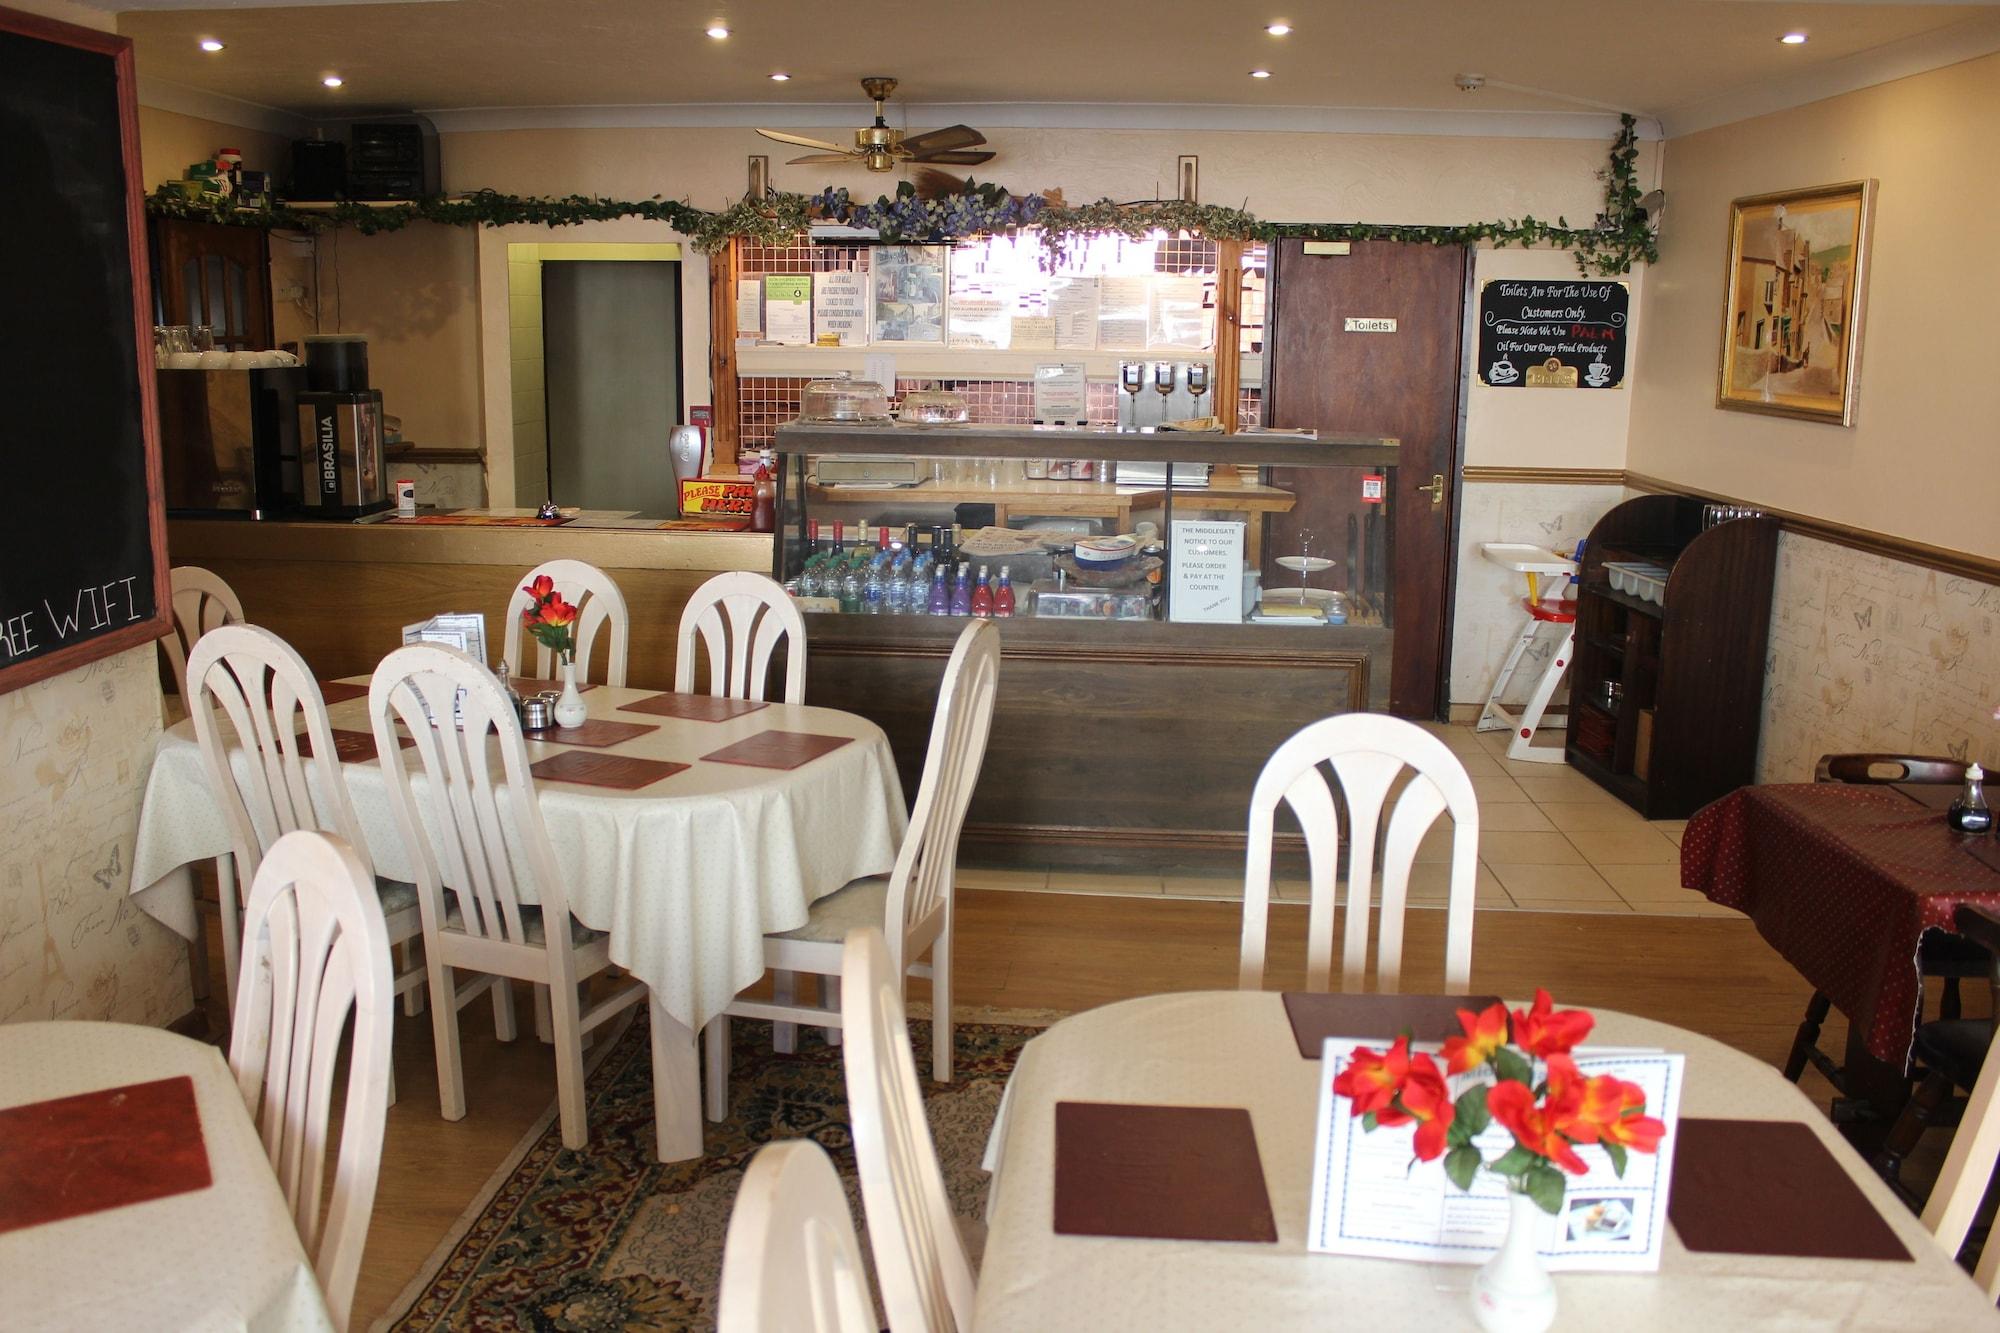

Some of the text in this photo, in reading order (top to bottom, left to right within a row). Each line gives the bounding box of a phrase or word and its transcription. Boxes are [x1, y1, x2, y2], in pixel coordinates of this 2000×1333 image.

[1500, 283, 1612, 302] Toilets Are For The Use Of
[1521, 306, 1563, 320] Customers
[1352, 320, 1389, 330] Toilets
[1496, 324, 1519, 336] Please
[1519, 326, 1538, 336] Note
[1539, 326, 1551, 336] We
[1553, 327, 1566, 336] Use
[1496, 340, 1608, 356] Oil For Our Deep Fried Products
[321, 416, 336, 480] BRASILIA
[683, 484, 754, 501] PLEASE PAY
[700, 497, 753, 513] HERE
[1195, 527, 1235, 535] MIDDLEGATE
[44, 576, 141, 639] WIFI
[1203, 601, 1219, 612] THANK
